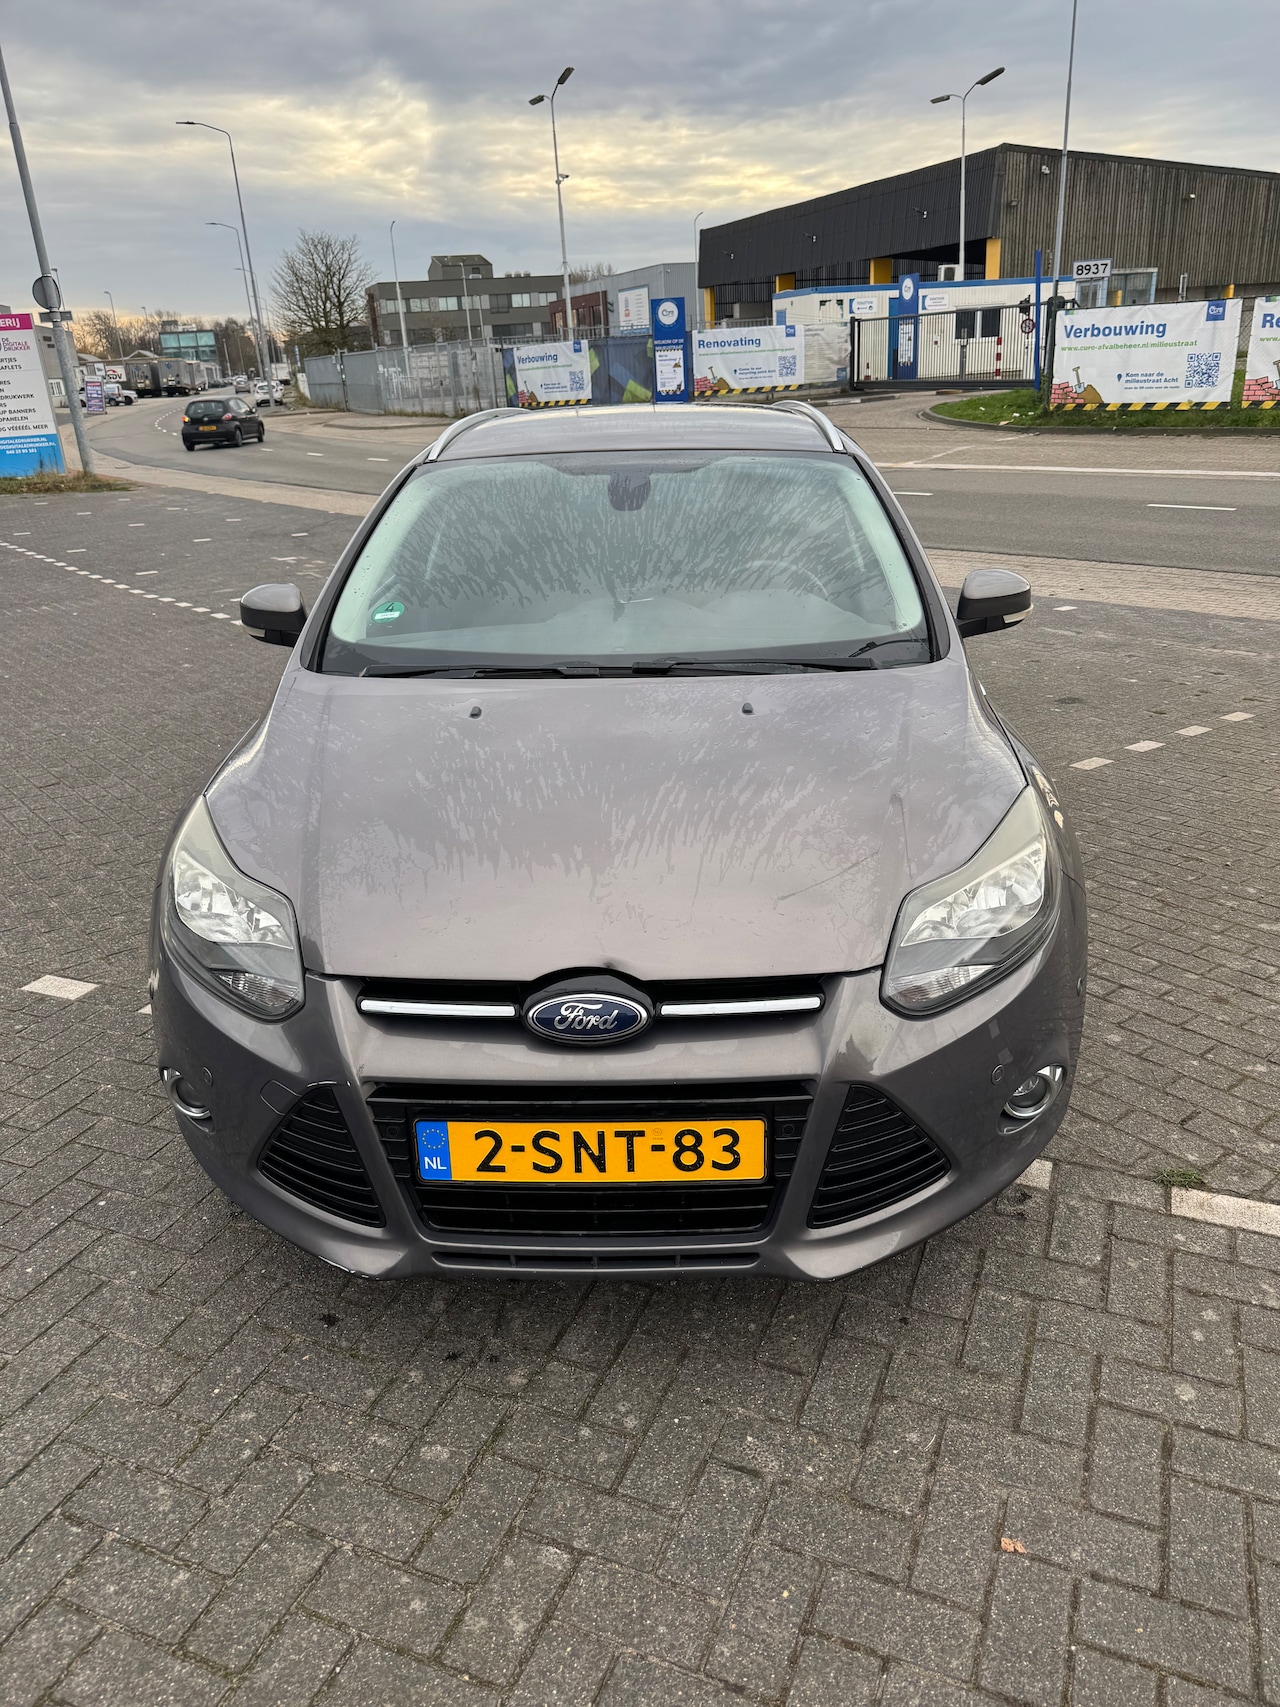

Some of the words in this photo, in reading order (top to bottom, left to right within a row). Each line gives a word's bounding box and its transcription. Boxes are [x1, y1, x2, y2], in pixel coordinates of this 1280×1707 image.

[1075, 262, 1109, 276] 8937
[1063, 320, 1167, 339] Verbouwing
[698, 337, 761, 349] Renovating
[517, 352, 558, 365] Verbouwing
[385, 602, 394, 612] 4
[554, 1002, 619, 1030] Ford
[474, 1128, 741, 1174] 2-SNT-83
[423, 1156, 447, 1171] NL
